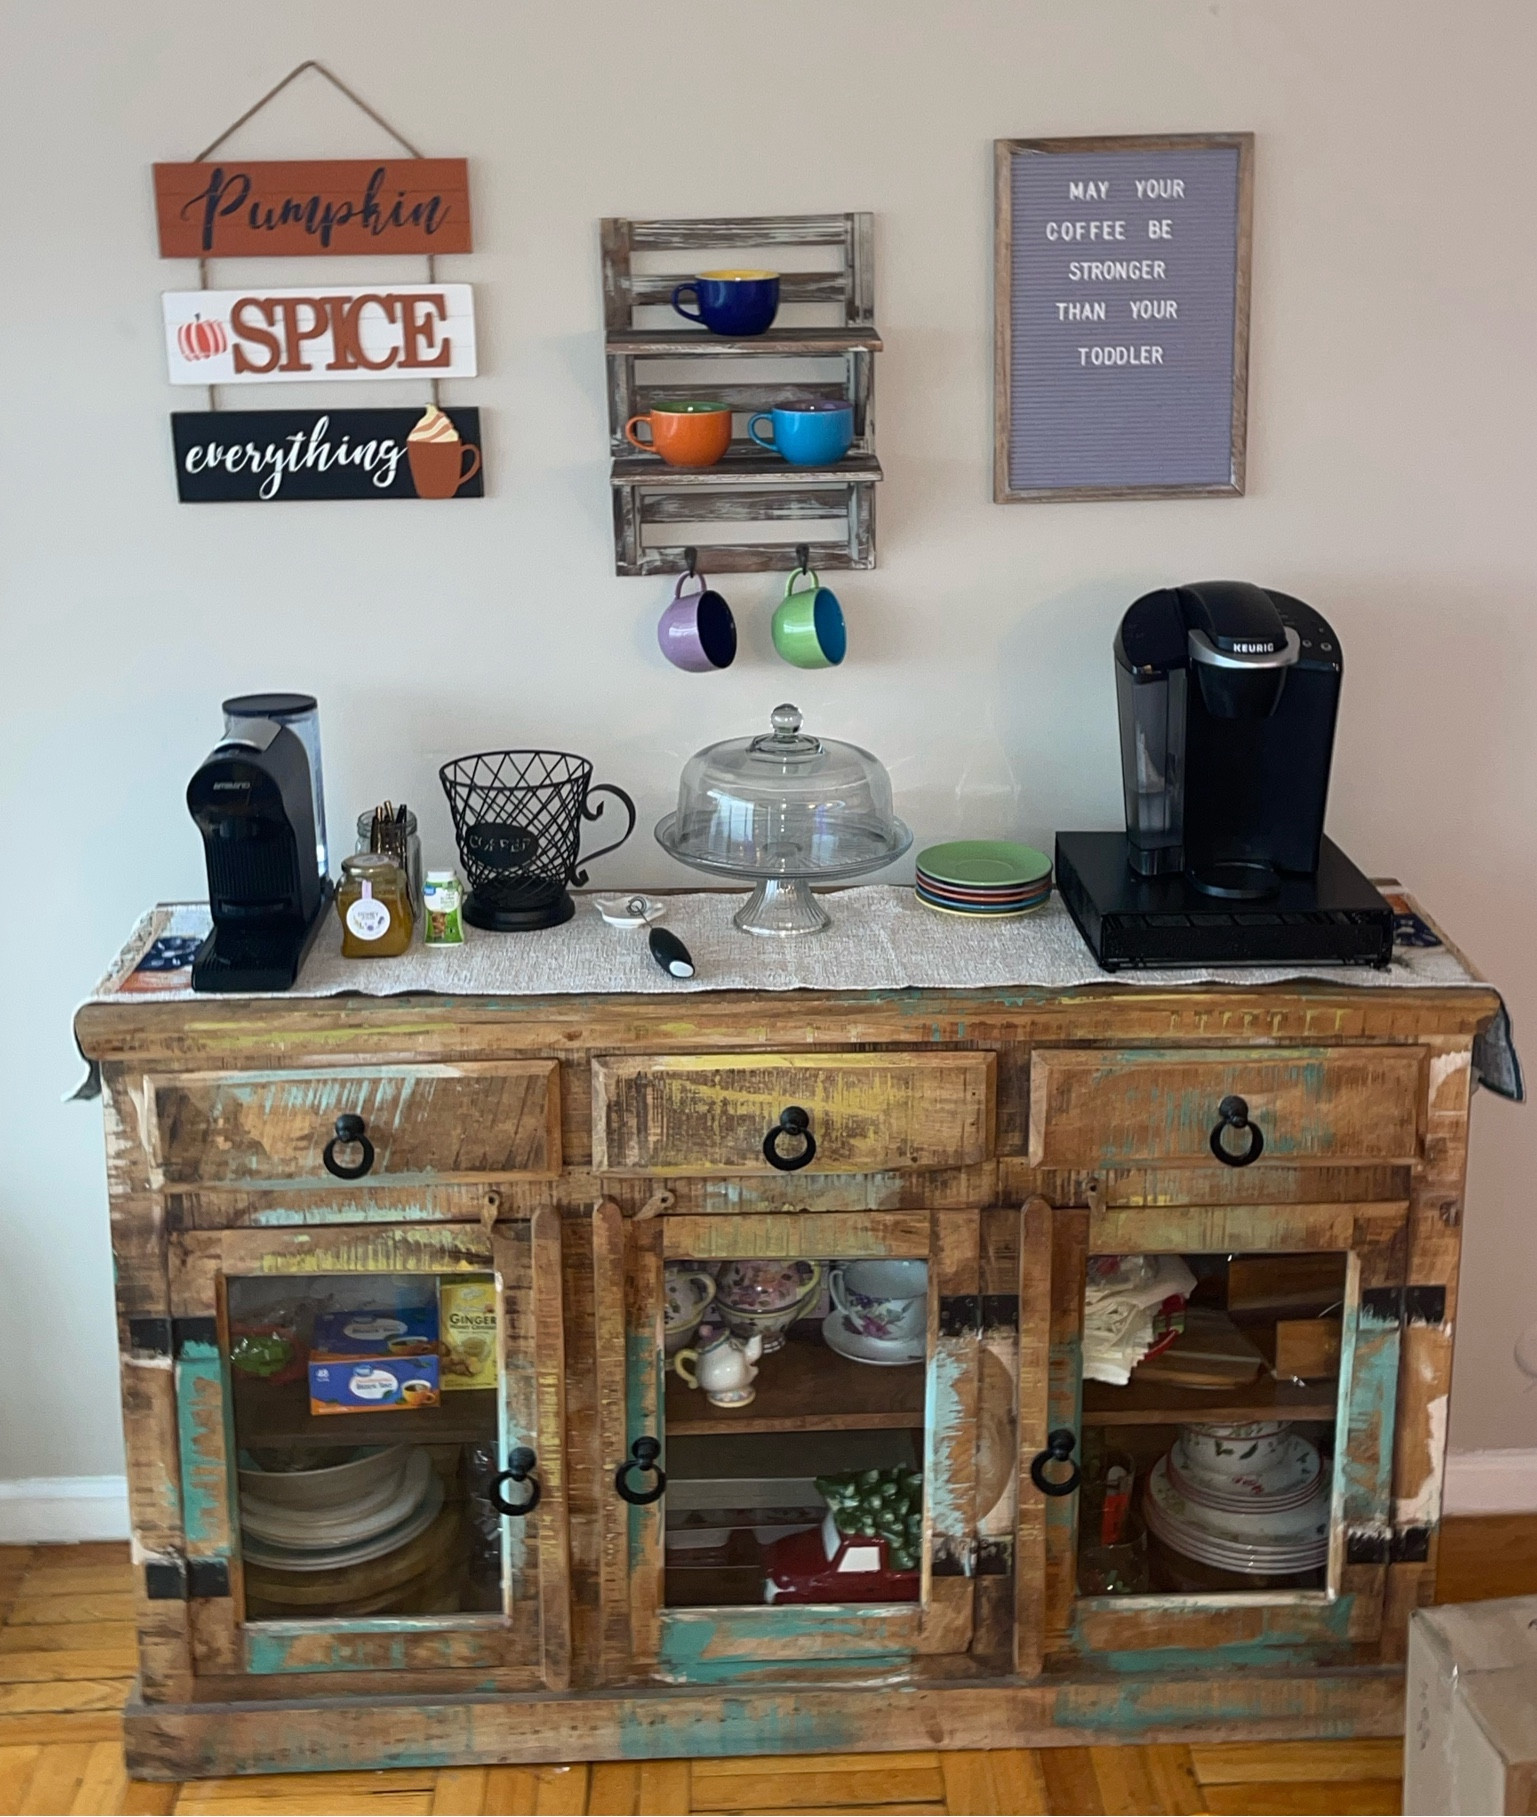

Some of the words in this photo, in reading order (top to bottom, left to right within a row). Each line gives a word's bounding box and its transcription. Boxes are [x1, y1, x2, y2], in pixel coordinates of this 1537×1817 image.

[1069, 181, 1109, 200] MAY
[1135, 179, 1185, 198] YOUR
[180, 167, 451, 251] Pumpkin
[1046, 221, 1126, 241] COFFEE
[1148, 219, 1173, 239] BE
[1068, 260, 1166, 281] STRONGER
[1055, 302, 1106, 321] THAN
[1129, 300, 1178, 319] YOUR
[230, 294, 451, 374] SPICE
[1077, 346, 1164, 366] TODDLER
[185, 415, 408, 500] everything
[1233, 642, 1275, 653] KEURIG
[449, 1313, 497, 1325] GINGER
